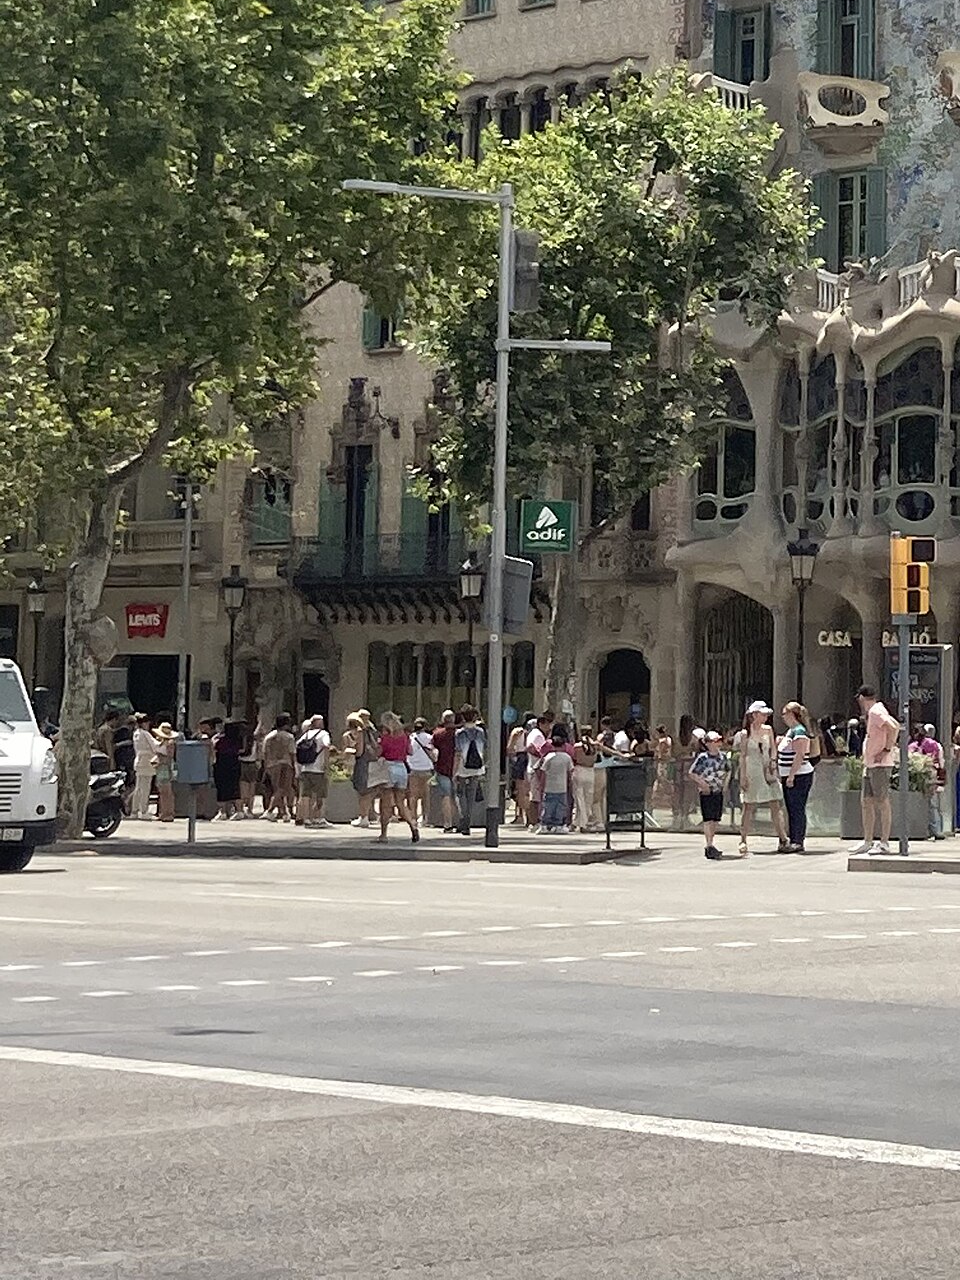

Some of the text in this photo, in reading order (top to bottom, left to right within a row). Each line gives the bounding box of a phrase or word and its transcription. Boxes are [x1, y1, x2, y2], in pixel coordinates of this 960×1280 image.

[526, 528, 567, 541] adif
[818, 630, 853, 648] CASA
[882, 626, 930, 648] BALÓ
